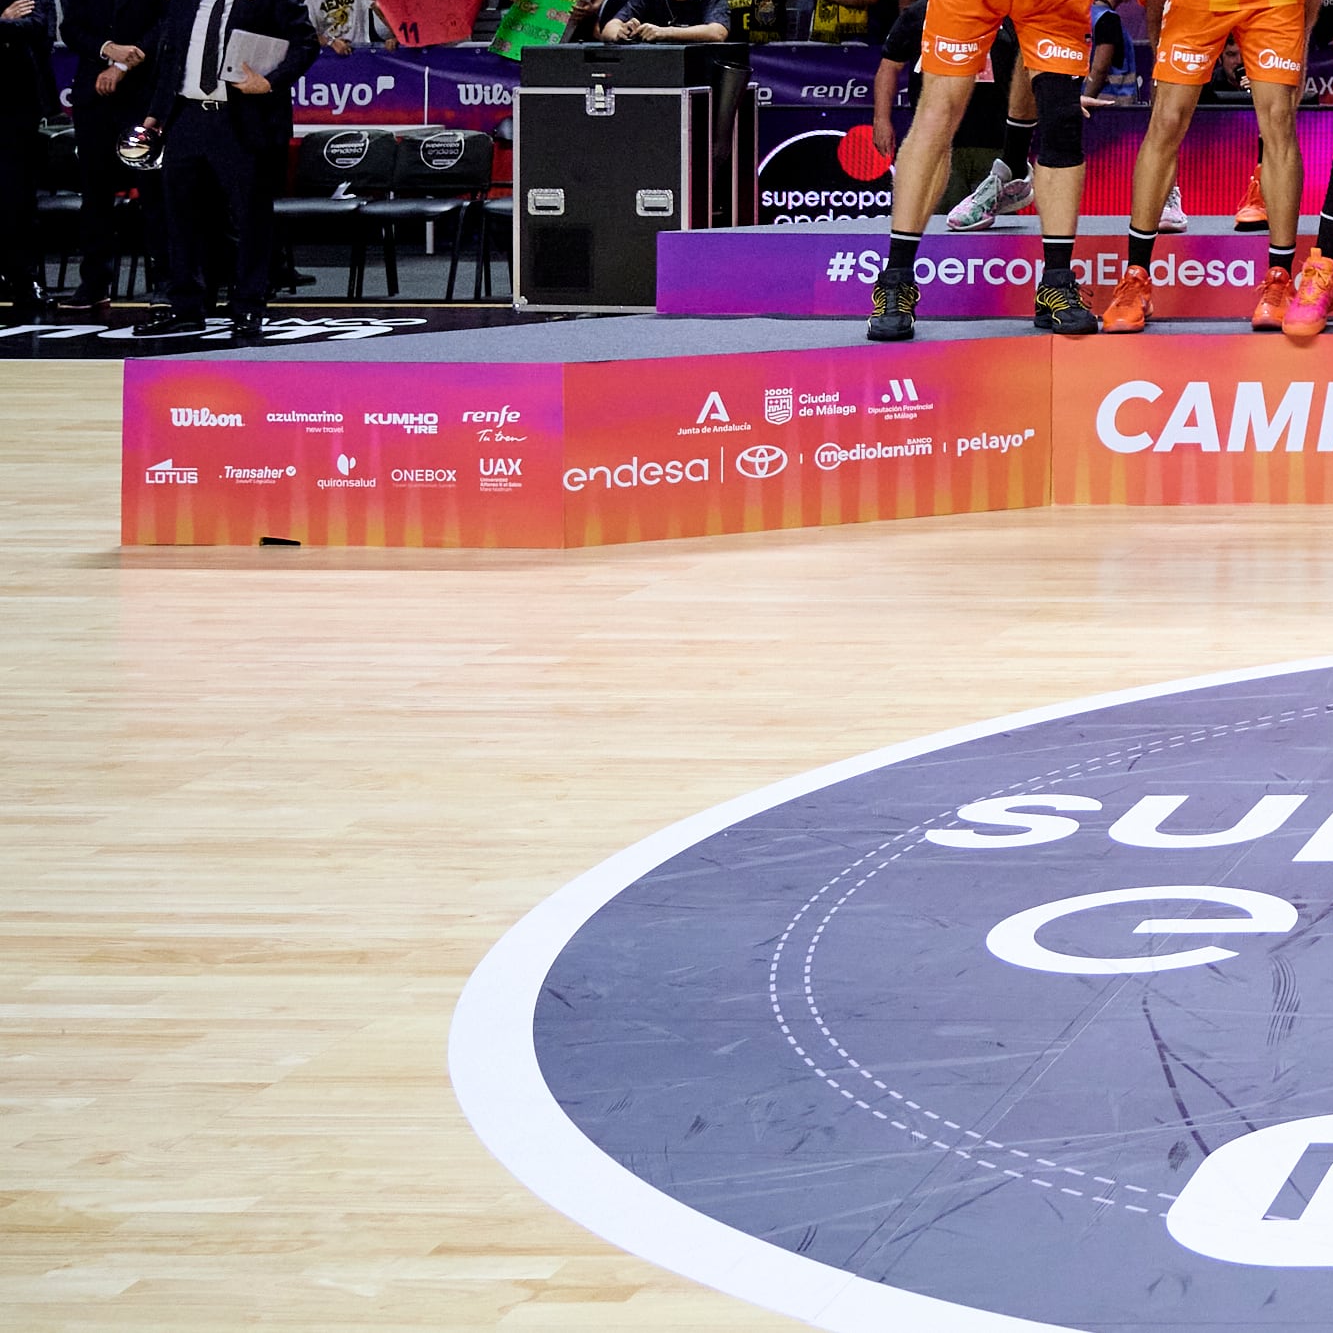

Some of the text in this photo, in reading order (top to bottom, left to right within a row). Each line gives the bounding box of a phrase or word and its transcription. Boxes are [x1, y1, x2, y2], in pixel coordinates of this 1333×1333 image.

[938, 40, 977, 55] PULEVA
[801, 79, 868, 104] renfe
[762, 191, 891, 211] supercopa
[799, 392, 839, 404] Ciudad
[170, 408, 243, 426] Wilson
[267, 411, 343, 422] azulmarino
[463, 405, 520, 428] renfe
[799, 405, 856, 416] de Málaga
[365, 414, 438, 424] KUMHO
[713, 421, 751, 432] Andalucía
[819, 440, 932, 463] mediolanum
[957, 433, 1023, 456] pelayo
[480, 459, 521, 475] UAX
[563, 457, 708, 491] endesa
[146, 472, 197, 483] LOTUS
[392, 469, 456, 481] ONEBOX
